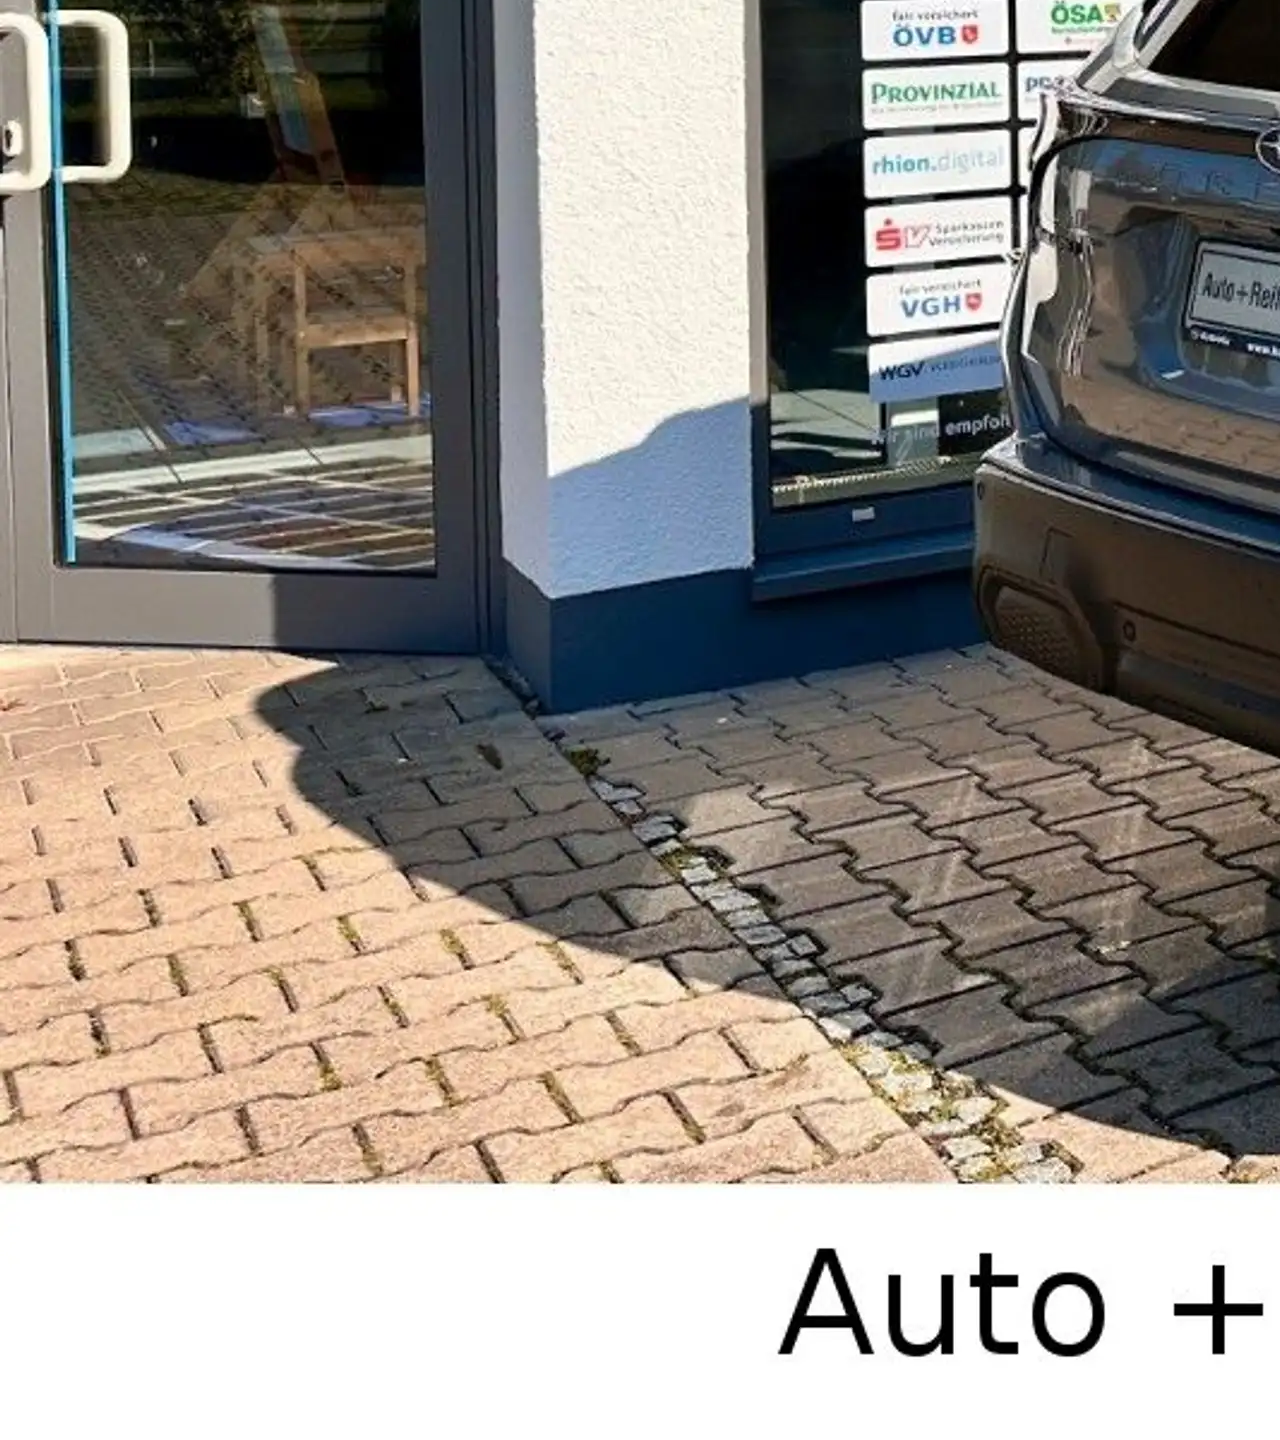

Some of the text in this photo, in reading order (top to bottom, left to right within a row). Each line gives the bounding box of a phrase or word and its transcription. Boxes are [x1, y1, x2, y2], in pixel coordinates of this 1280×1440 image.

[1051, 0, 1104, 25] ÖSA
[892, 24, 957, 47] ÖVB
[871, 148, 1005, 176] rhion.digital
[901, 295, 962, 319] VGH
[880, 361, 925, 381] WGV
